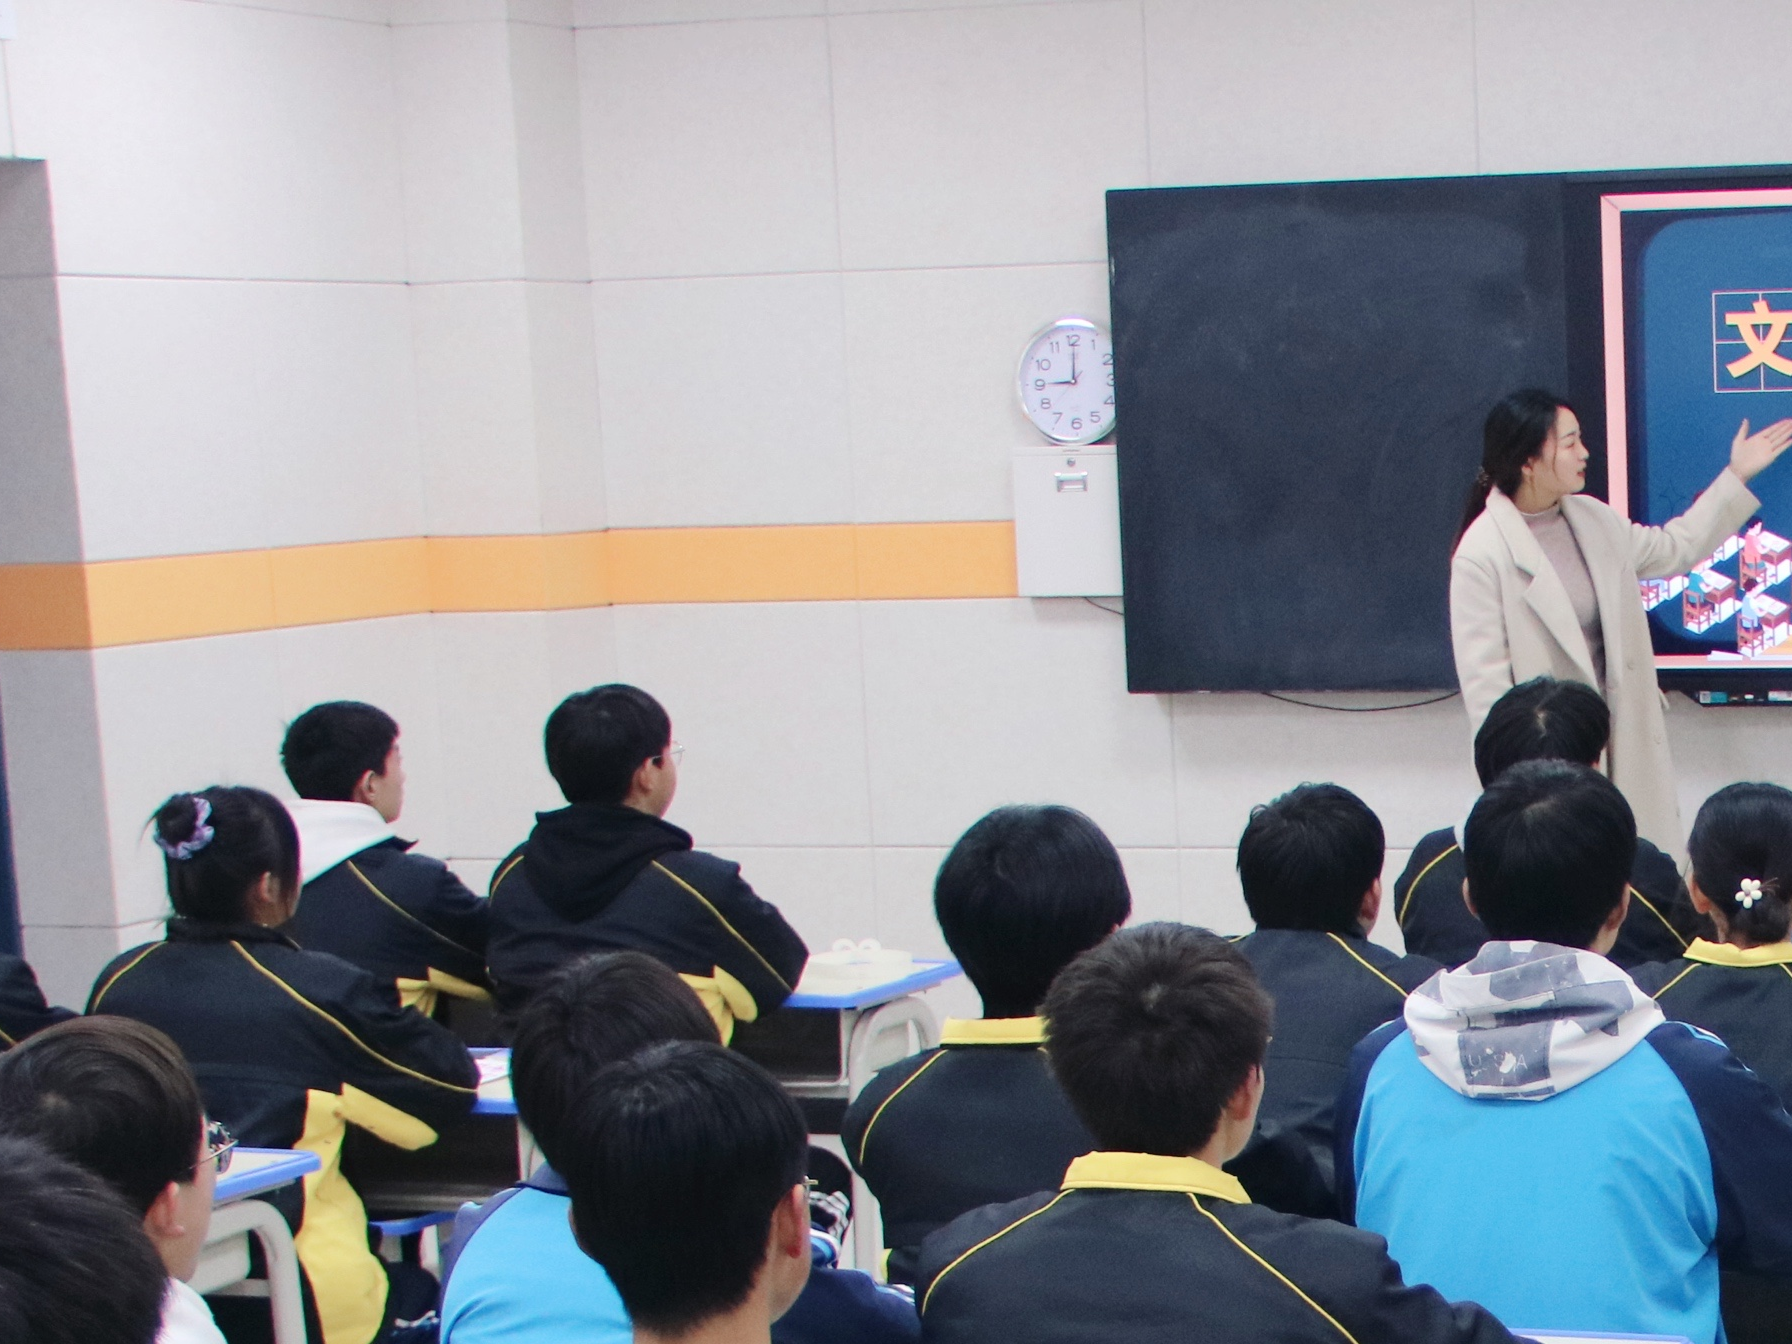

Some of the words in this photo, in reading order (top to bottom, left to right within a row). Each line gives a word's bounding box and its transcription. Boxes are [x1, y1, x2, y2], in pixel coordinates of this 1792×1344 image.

[1066, 334, 1081, 346] 12
[1050, 341, 1060, 353] 11
[1036, 359, 1051, 371] 10
[1034, 379, 1046, 391] 9
[1040, 398, 1051, 410] 8
[1052, 412, 1063, 424] 7
[1090, 411, 1101, 423] 5
[1071, 418, 1082, 430] 6
